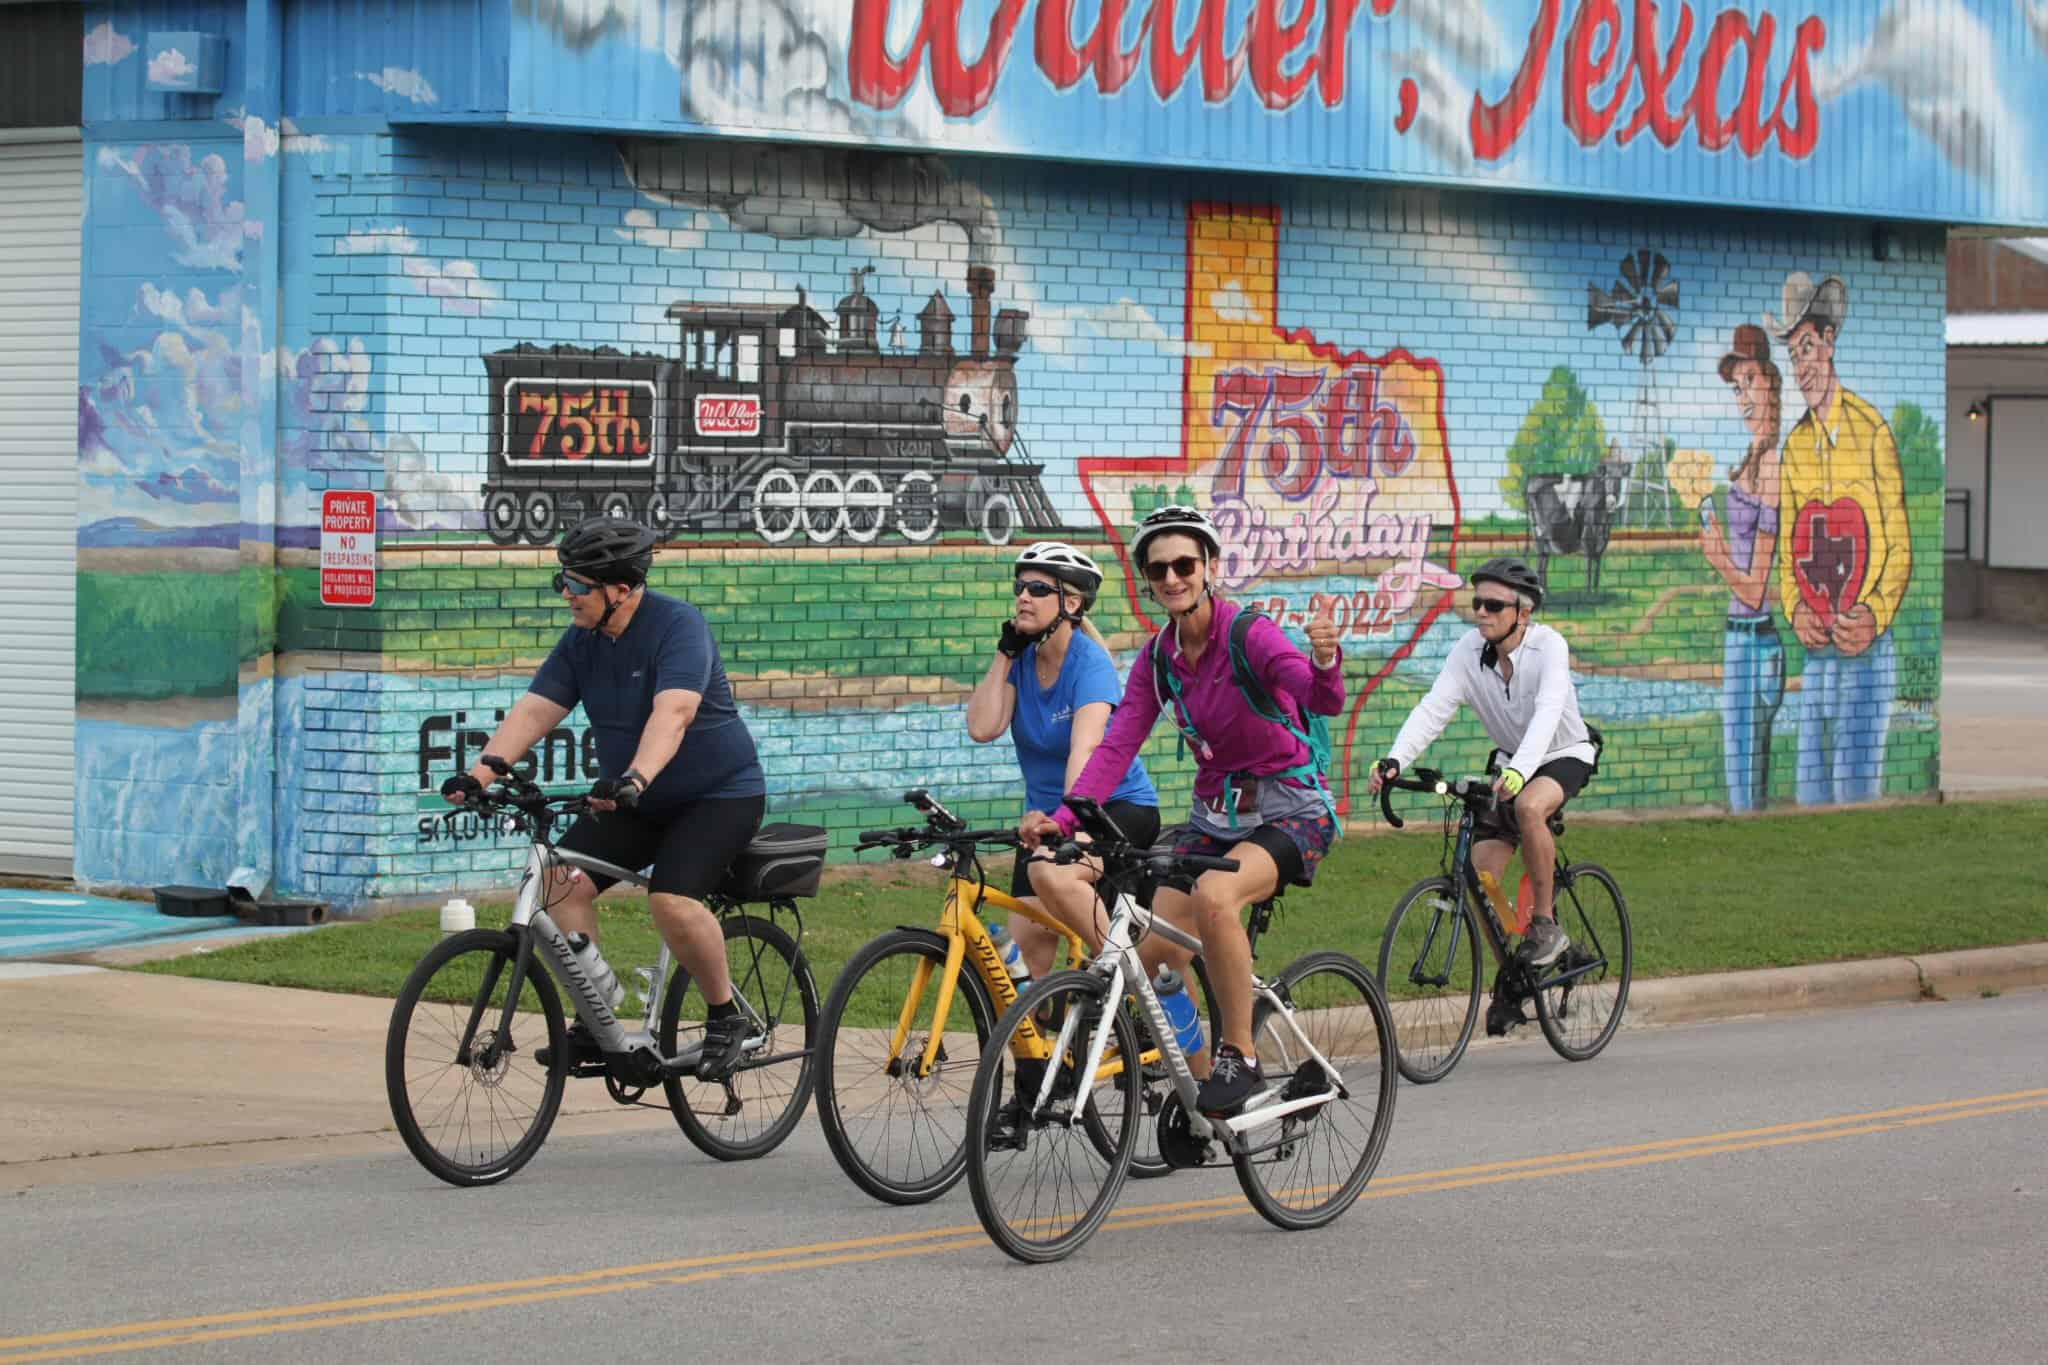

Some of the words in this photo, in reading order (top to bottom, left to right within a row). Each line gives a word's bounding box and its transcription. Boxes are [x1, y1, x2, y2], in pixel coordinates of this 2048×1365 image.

[1470, 0, 1826, 161] Texas
[519, 388, 650, 459] 75th
[1211, 365, 1416, 504] 75th
[324, 515, 372, 530] PROPERTY
[329, 499, 368, 514] PRIVATE
[323, 551, 373, 567] TRESPASSING
[339, 535, 357, 550] NO
[1212, 478, 1464, 617] Birthday
